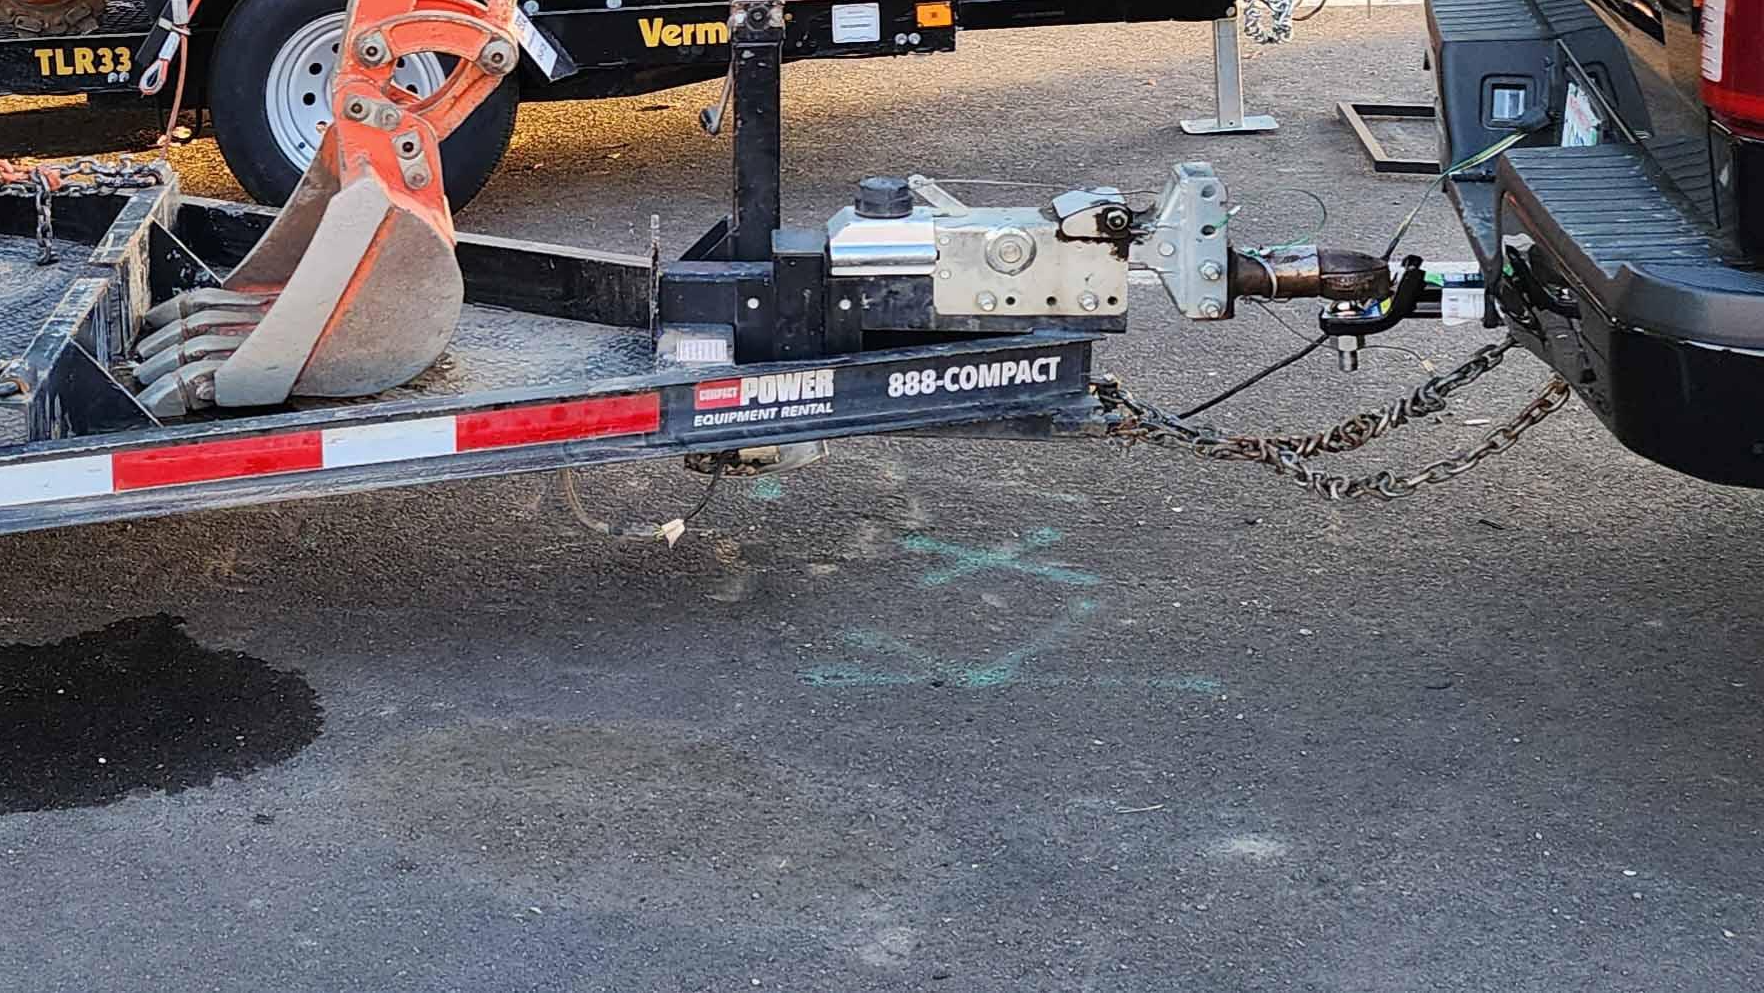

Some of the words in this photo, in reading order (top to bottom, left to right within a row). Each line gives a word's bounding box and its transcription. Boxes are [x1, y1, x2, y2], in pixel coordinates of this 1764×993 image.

[34, 46, 132, 76] TLR33
[740, 368, 836, 406] POWER
[887, 356, 1061, 398] 888-COMPACT
[694, 408, 779, 427] EQUIPMENT
[781, 401, 835, 419] RENTAL
